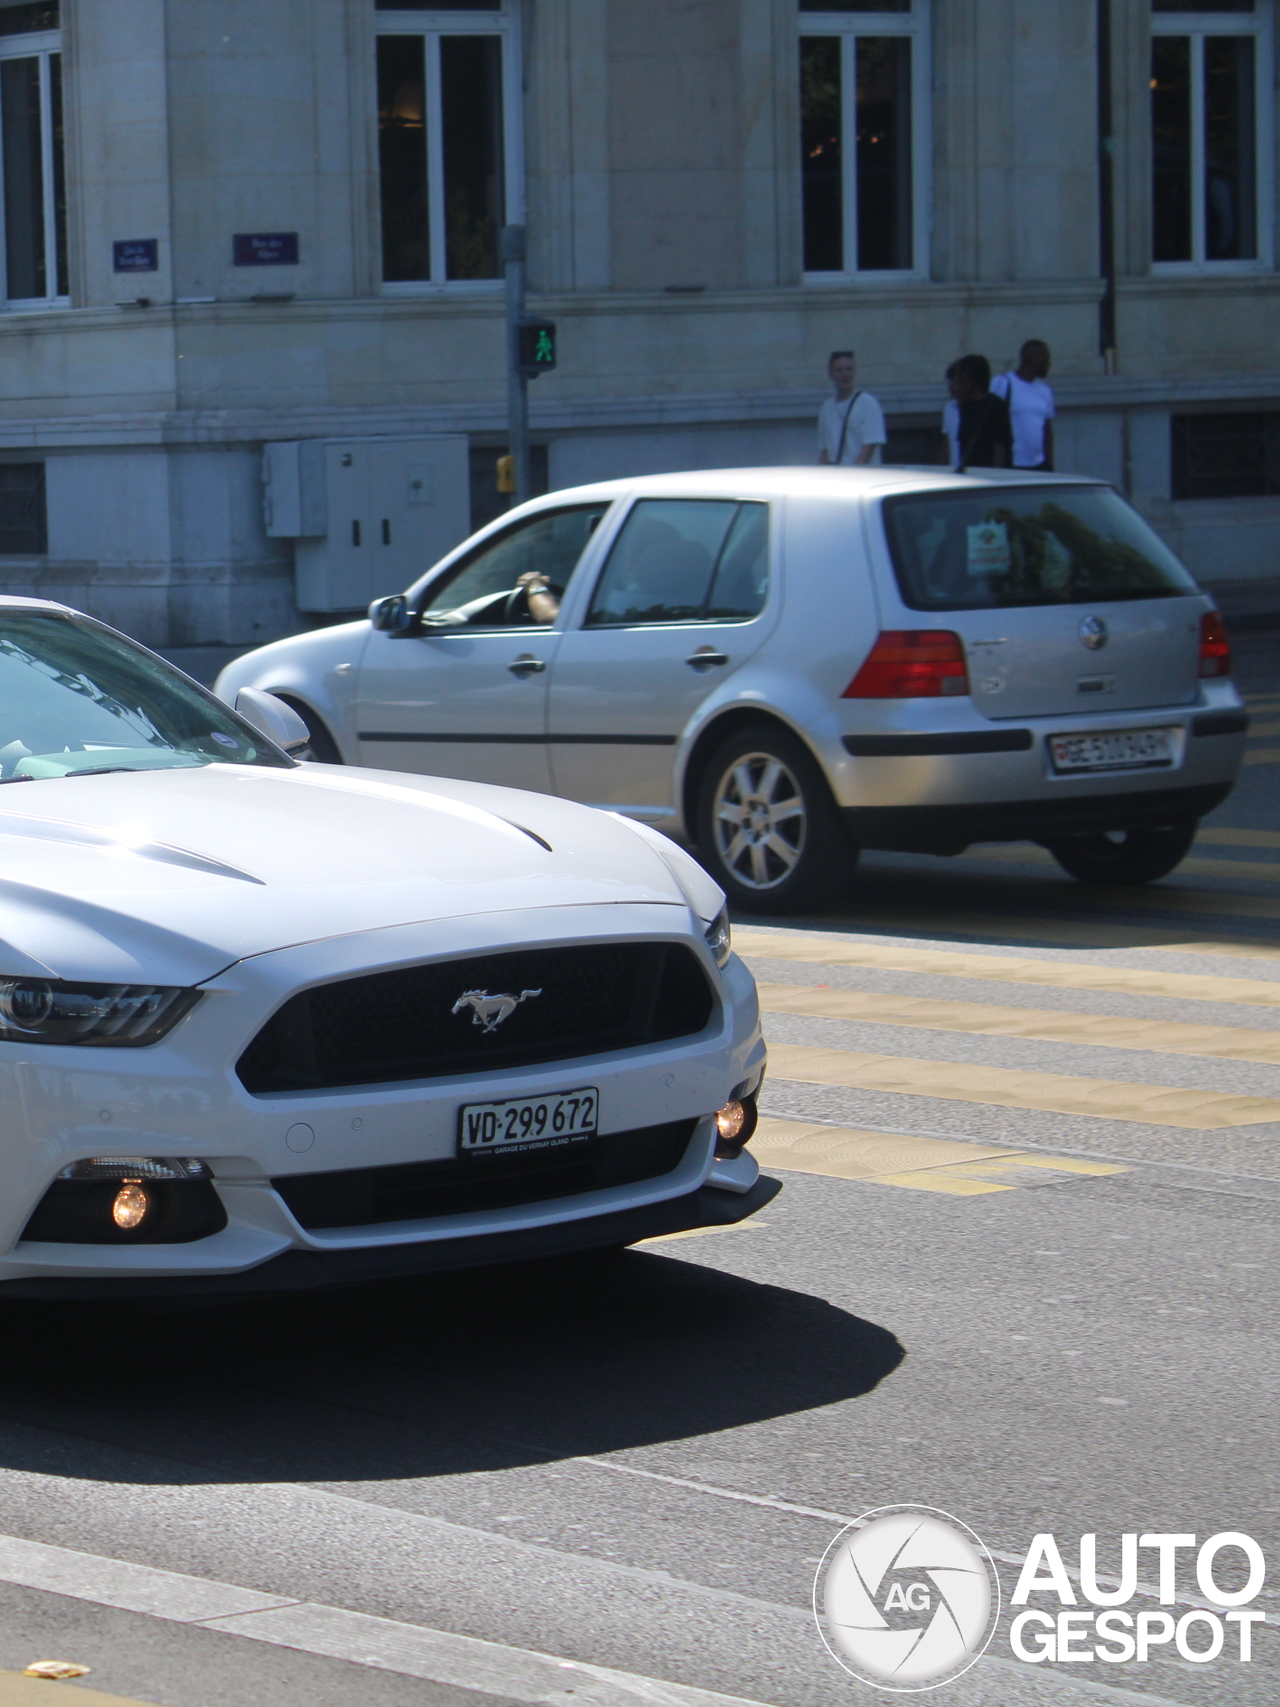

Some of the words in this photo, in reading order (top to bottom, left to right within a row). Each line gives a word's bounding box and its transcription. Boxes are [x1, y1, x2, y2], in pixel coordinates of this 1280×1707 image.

[494, 1145, 518, 1154] GARAGE
[528, 1140, 550, 1150] VERNAY
[550, 1137, 570, 1146] GLAND
